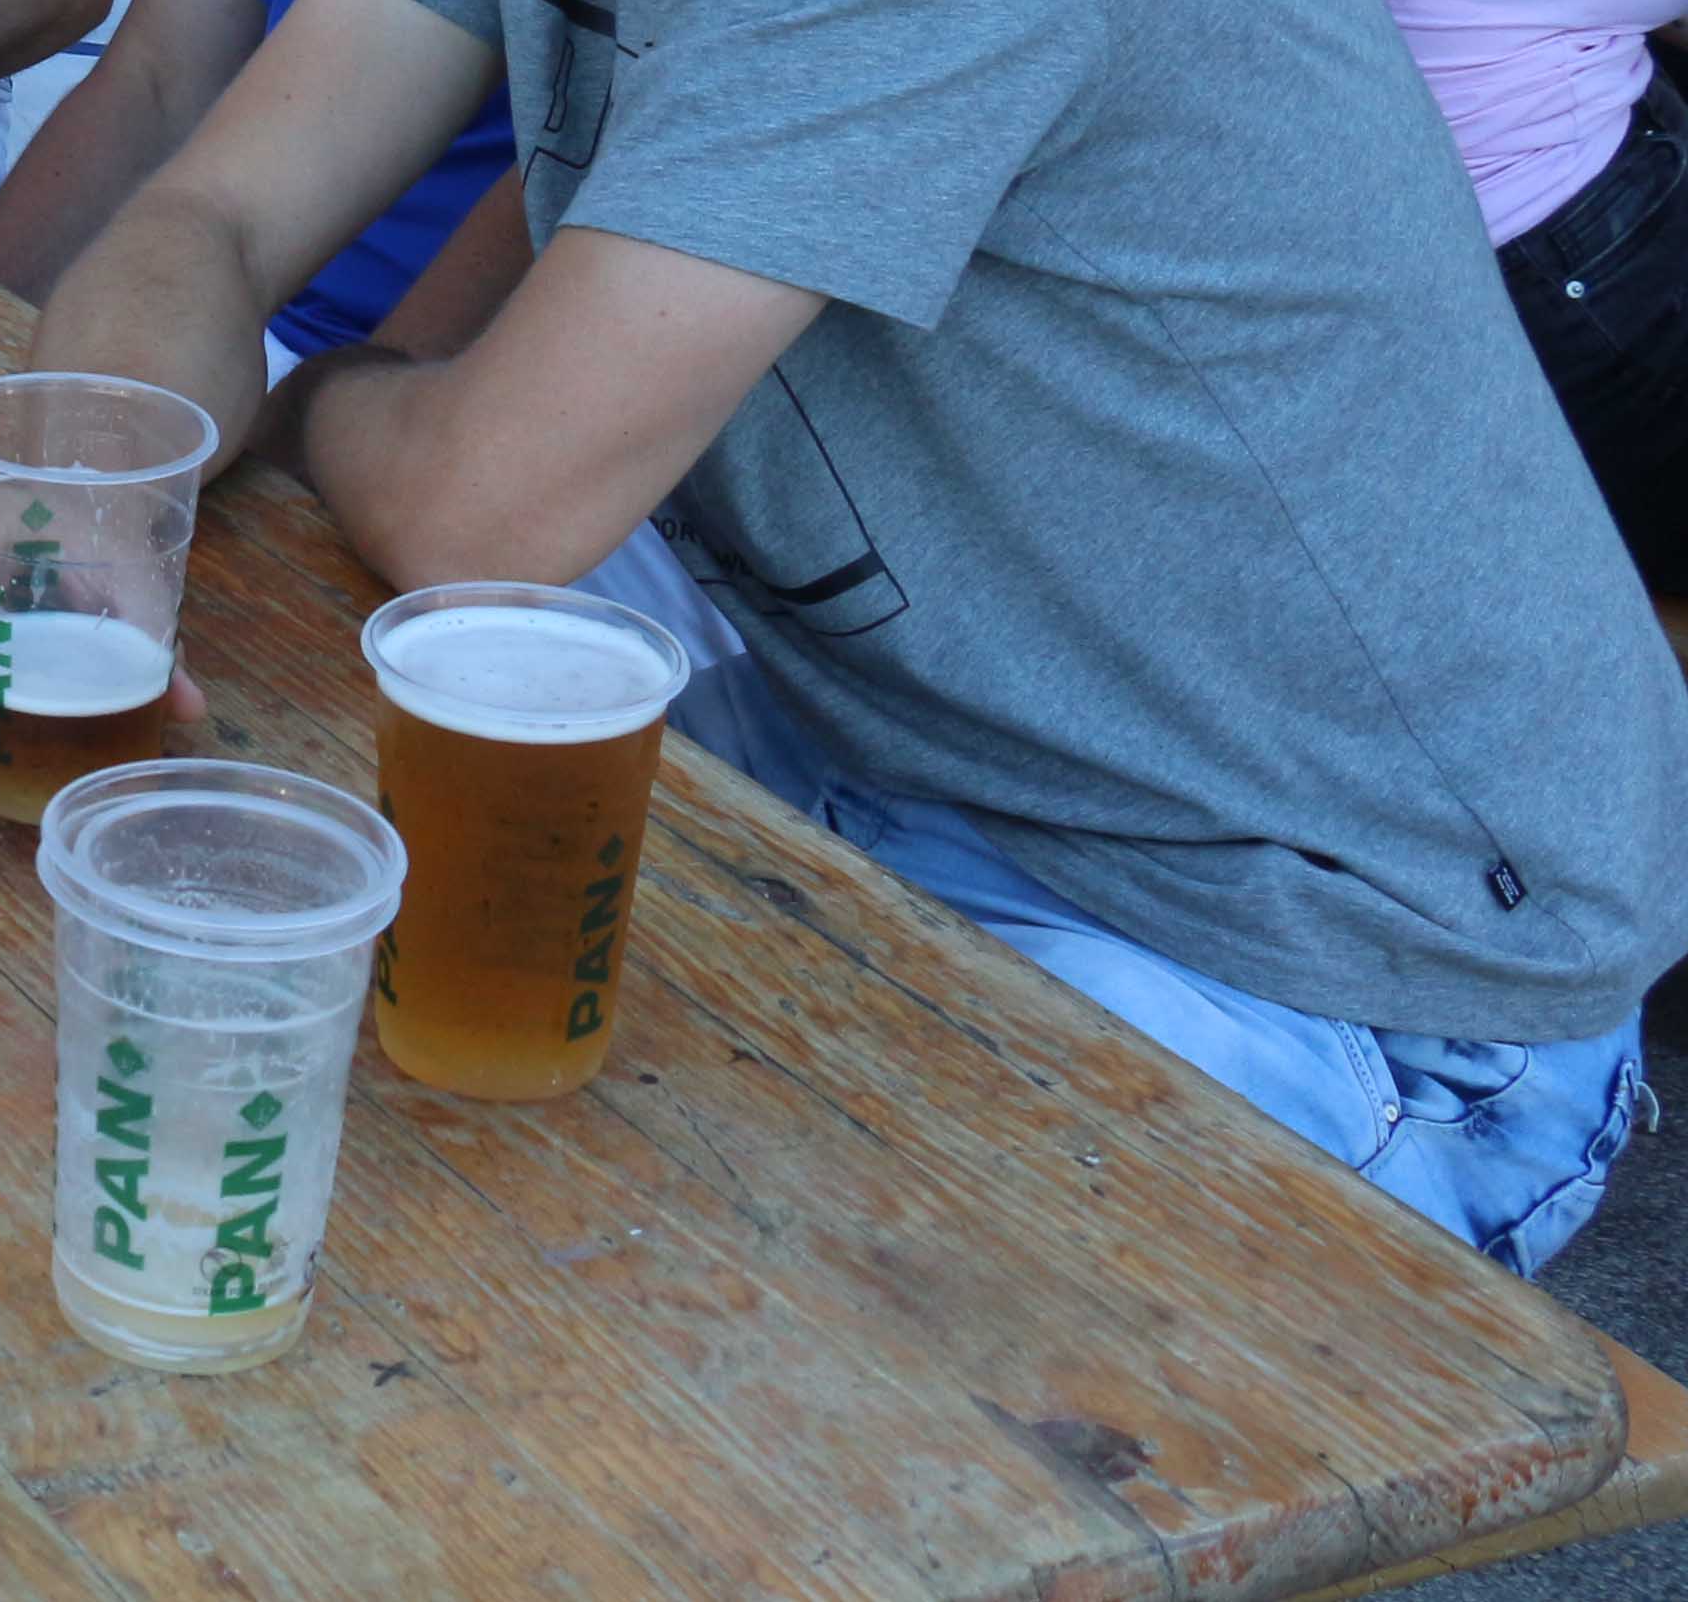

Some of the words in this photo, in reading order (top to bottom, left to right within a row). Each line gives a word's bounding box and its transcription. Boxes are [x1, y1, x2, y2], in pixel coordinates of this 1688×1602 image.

[567, 872, 623, 1042] PAN
[94, 1076, 153, 1271] PAN
[209, 1133, 287, 1317] PAN
